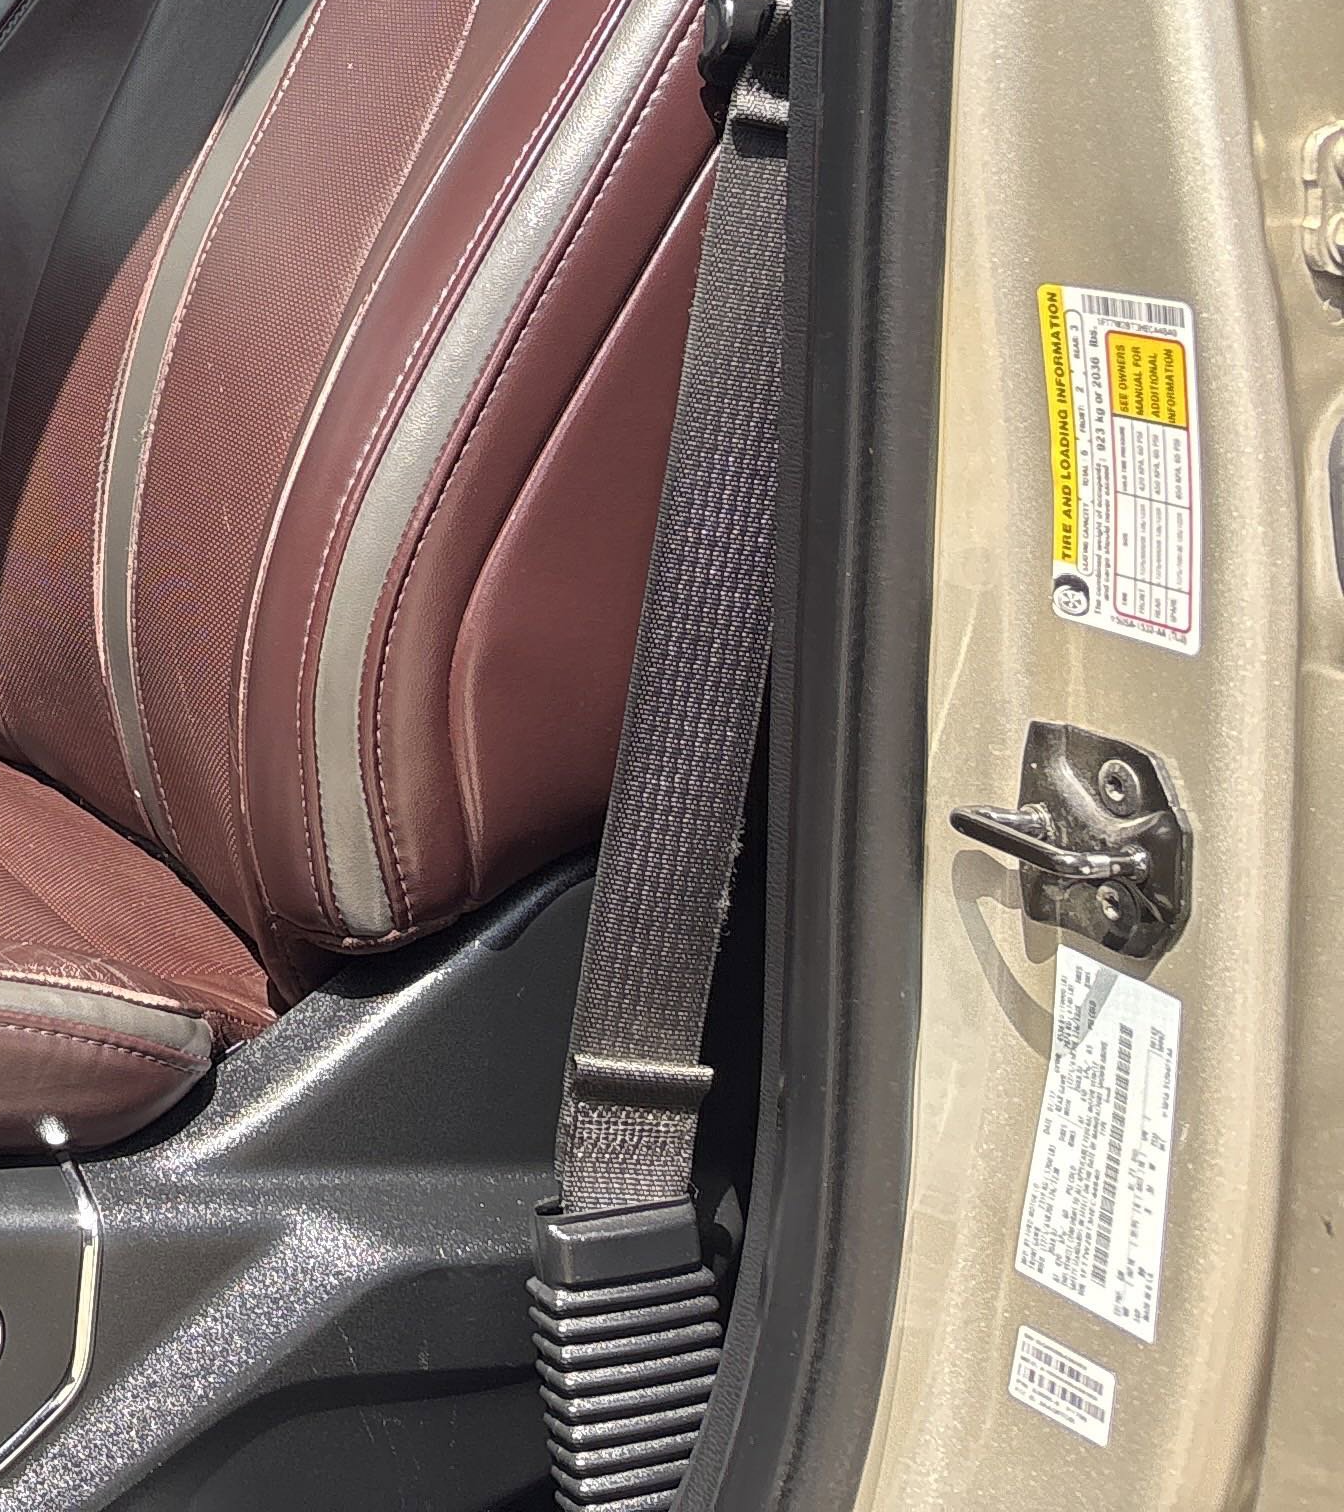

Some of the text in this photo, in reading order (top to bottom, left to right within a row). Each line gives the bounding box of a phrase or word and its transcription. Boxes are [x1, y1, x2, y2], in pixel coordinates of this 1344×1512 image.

[1095, 391, 1103, 404] or
[1115, 343, 1129, 412] SEE OWNERS
[1132, 345, 1144, 415] MANUAL FOR
[1148, 352, 1160, 418] ADDITIONAL
[1162, 348, 1176, 423] INFORMATION
[1049, 290, 1073, 562] TIRE AND LOADING INFORMATION
[1093, 407, 1105, 423] kg
